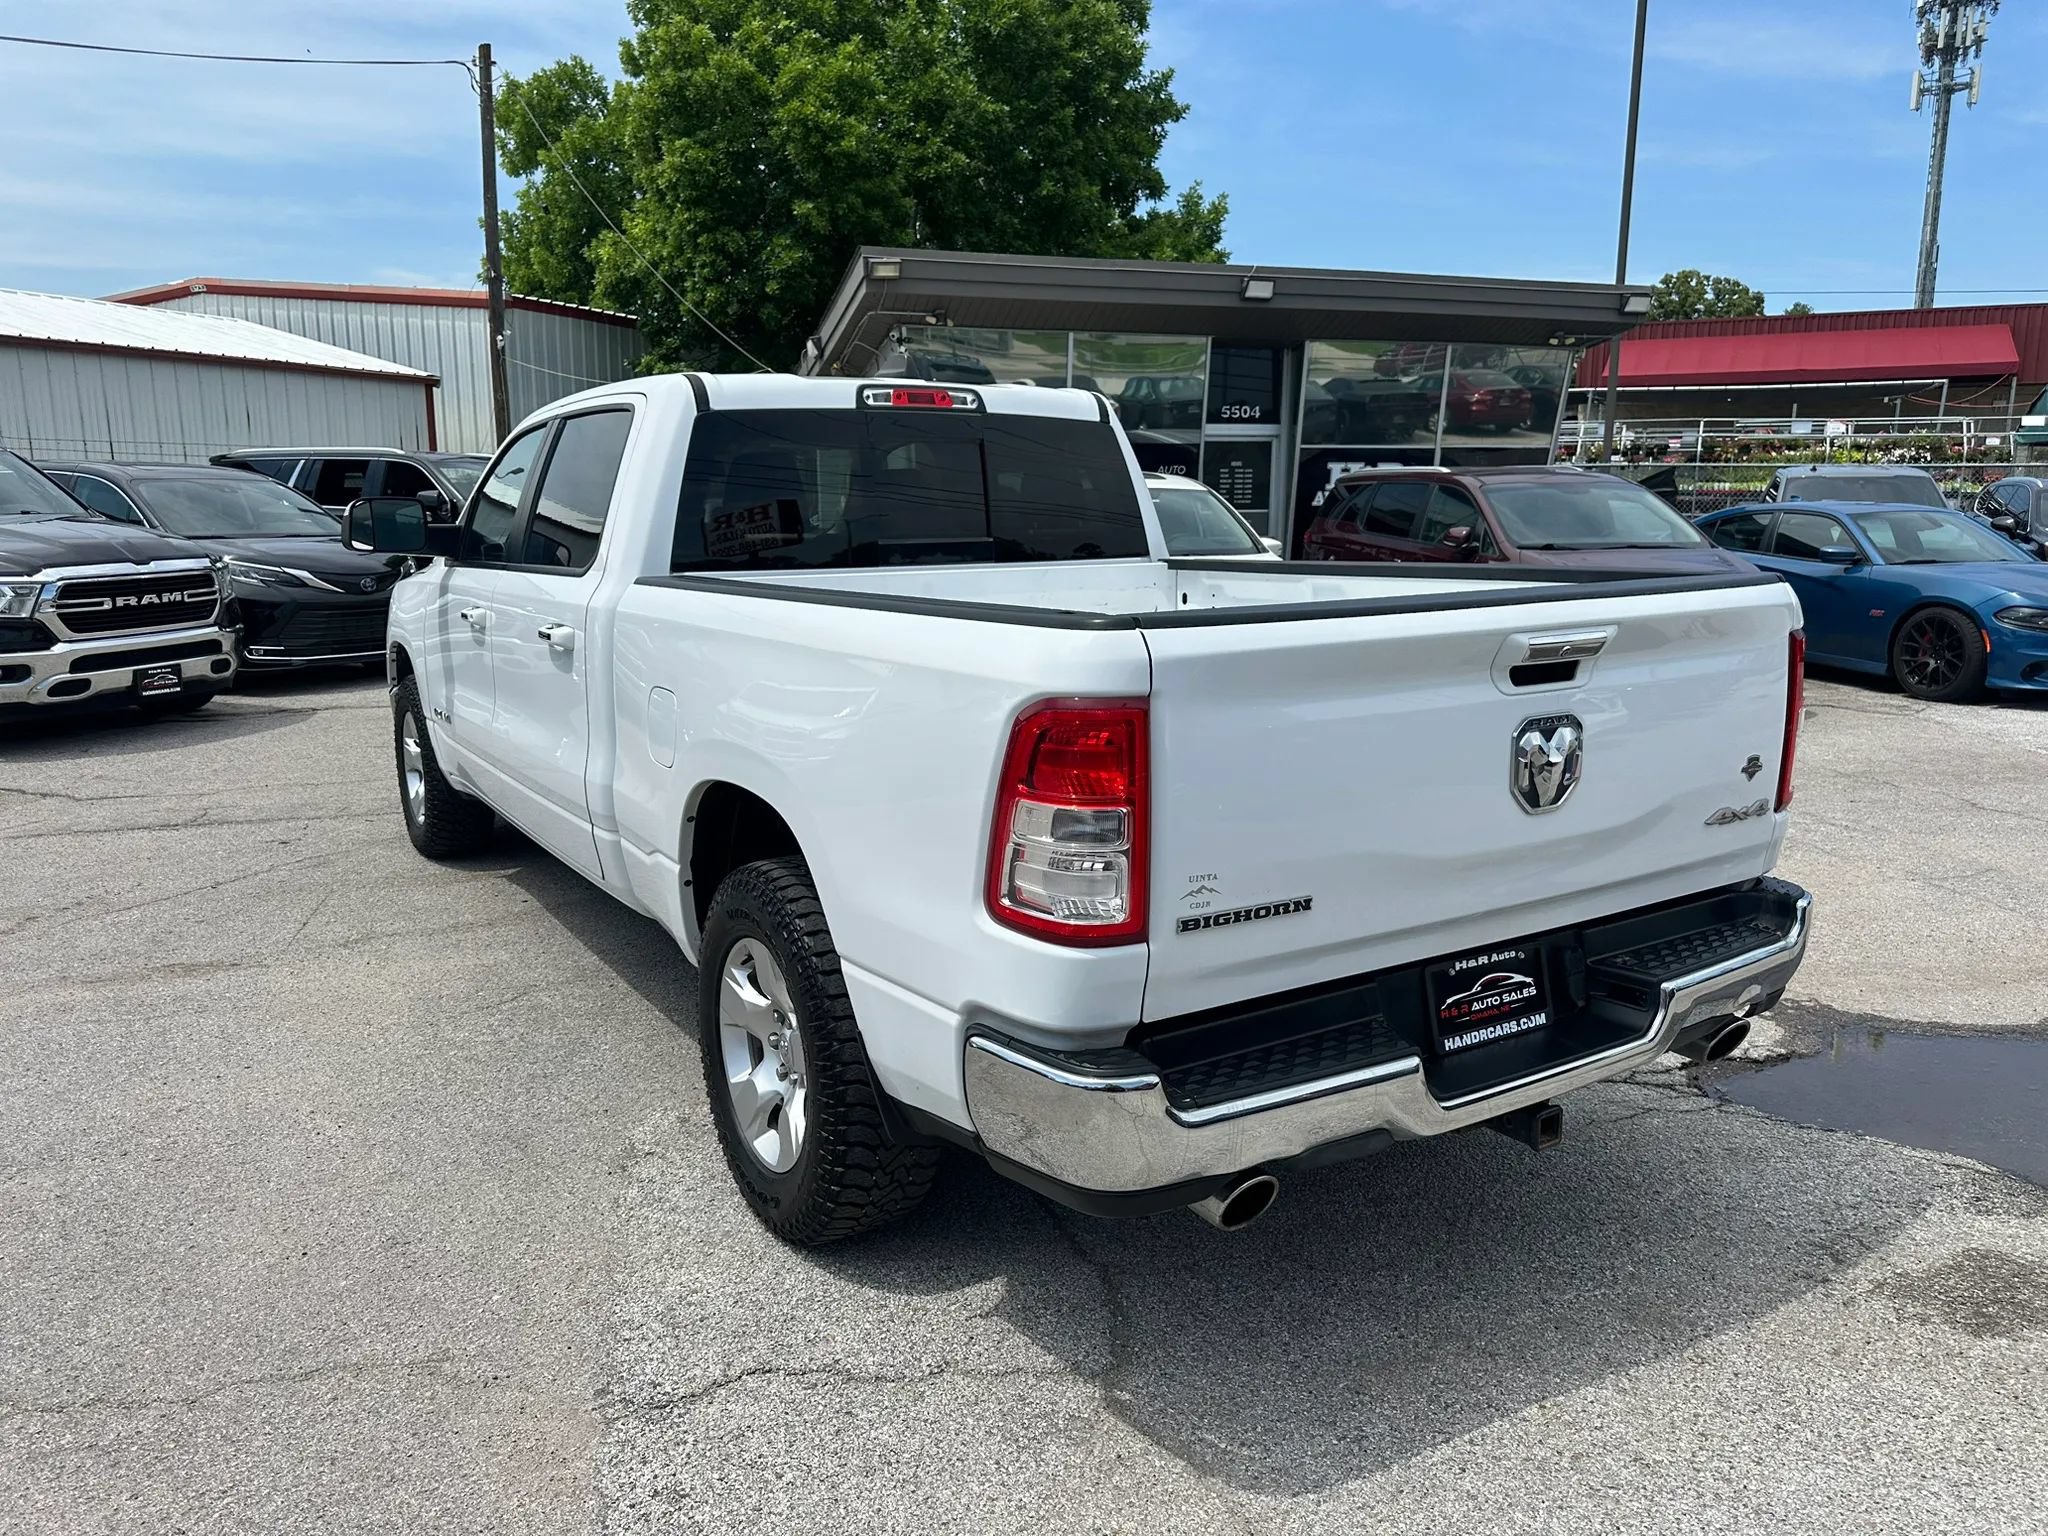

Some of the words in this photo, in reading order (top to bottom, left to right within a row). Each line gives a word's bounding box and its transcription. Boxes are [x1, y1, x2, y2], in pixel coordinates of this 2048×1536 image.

[1220, 405, 1261, 419] 5504
[1158, 465, 1187, 475] AUTO
[115, 591, 182, 607] RAM
[1188, 873, 1219, 883] UINTA
[1178, 896, 1314, 934] BIGHORN
[1454, 955, 1490, 971] H&R
[1490, 950, 1516, 963] Auto
[1471, 996, 1501, 1011] AUTO
[1502, 986, 1537, 1003] SALES
[1444, 1012, 1547, 1051] HANDRCARS.COM
